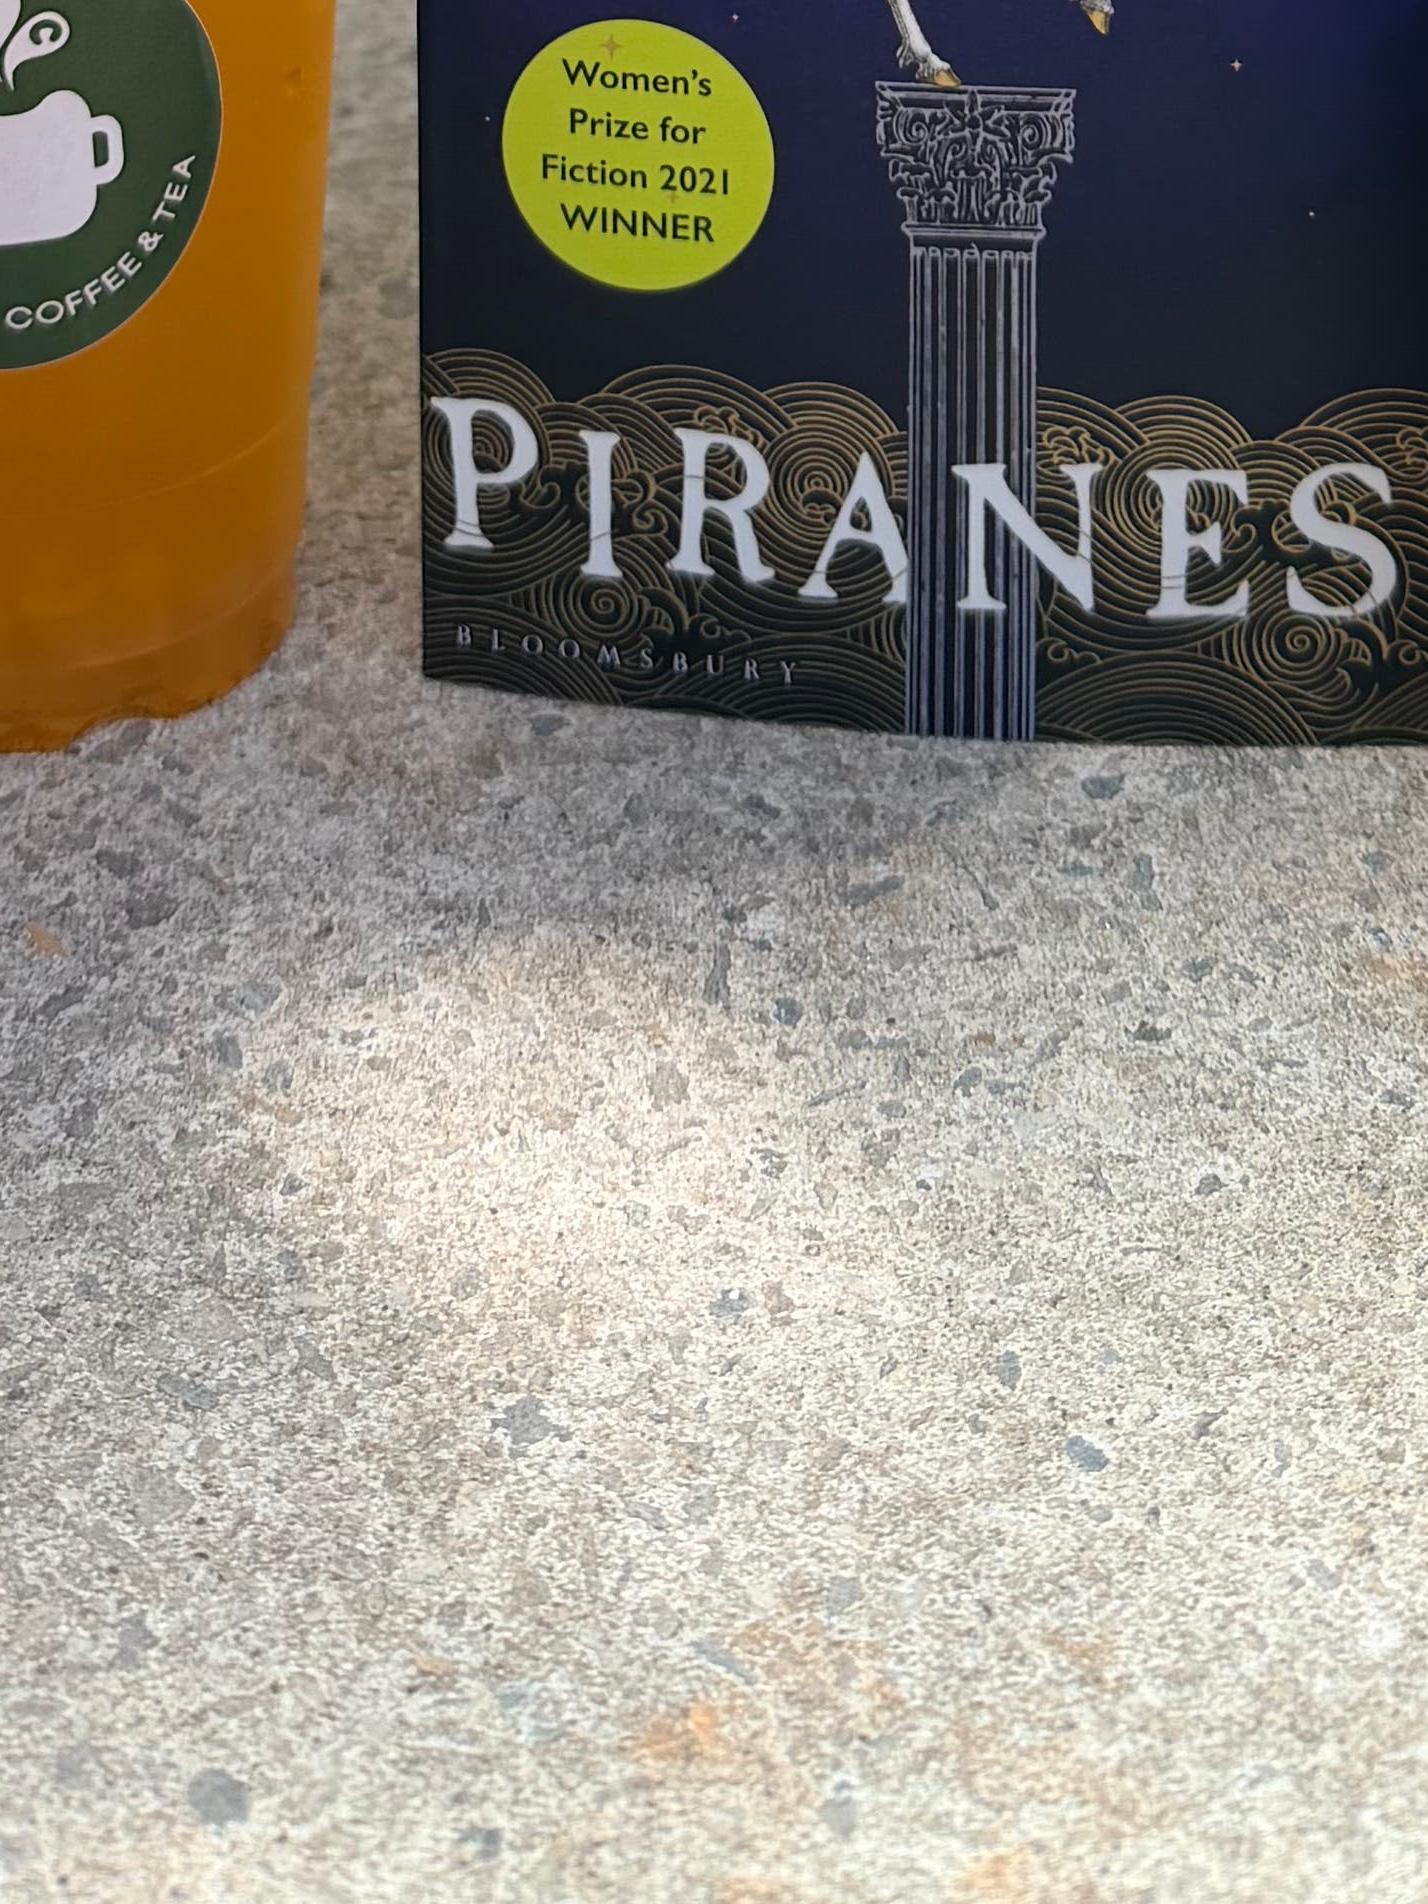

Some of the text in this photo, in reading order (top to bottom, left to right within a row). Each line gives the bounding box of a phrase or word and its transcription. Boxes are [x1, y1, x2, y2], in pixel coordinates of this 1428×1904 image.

[562, 58, 713, 97] Women’s
[569, 108, 706, 145] Prize for
[541, 153, 730, 196] Fiction 2021
[4, 251, 143, 331] COFFEE
[137, 230, 164, 253] &
[153, 154, 197, 225] TEA
[560, 203, 716, 243] WINNER
[456, 623, 797, 685] BLOOMSBURY
